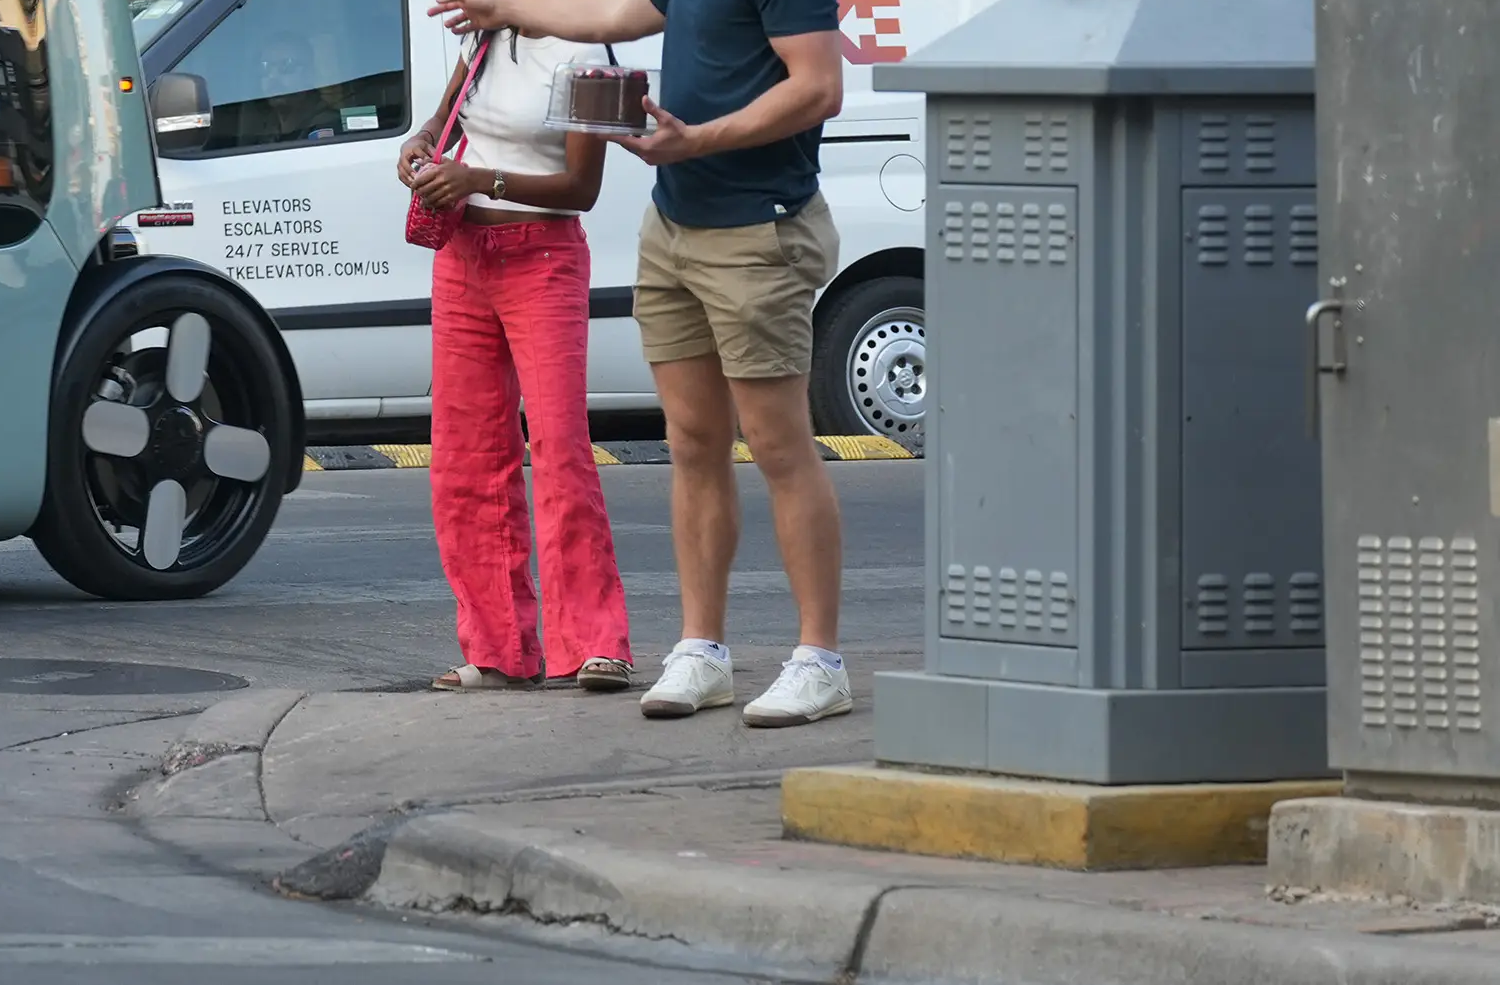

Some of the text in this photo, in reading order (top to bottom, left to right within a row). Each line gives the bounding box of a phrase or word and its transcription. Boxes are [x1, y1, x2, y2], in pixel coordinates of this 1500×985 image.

[222, 198, 312, 215] ELEVATORS
[224, 219, 323, 237] ESCALATORS
[225, 240, 340, 259] 24/7 SERVICE
[226, 260, 390, 281] TKELEVATOR.COM/US
